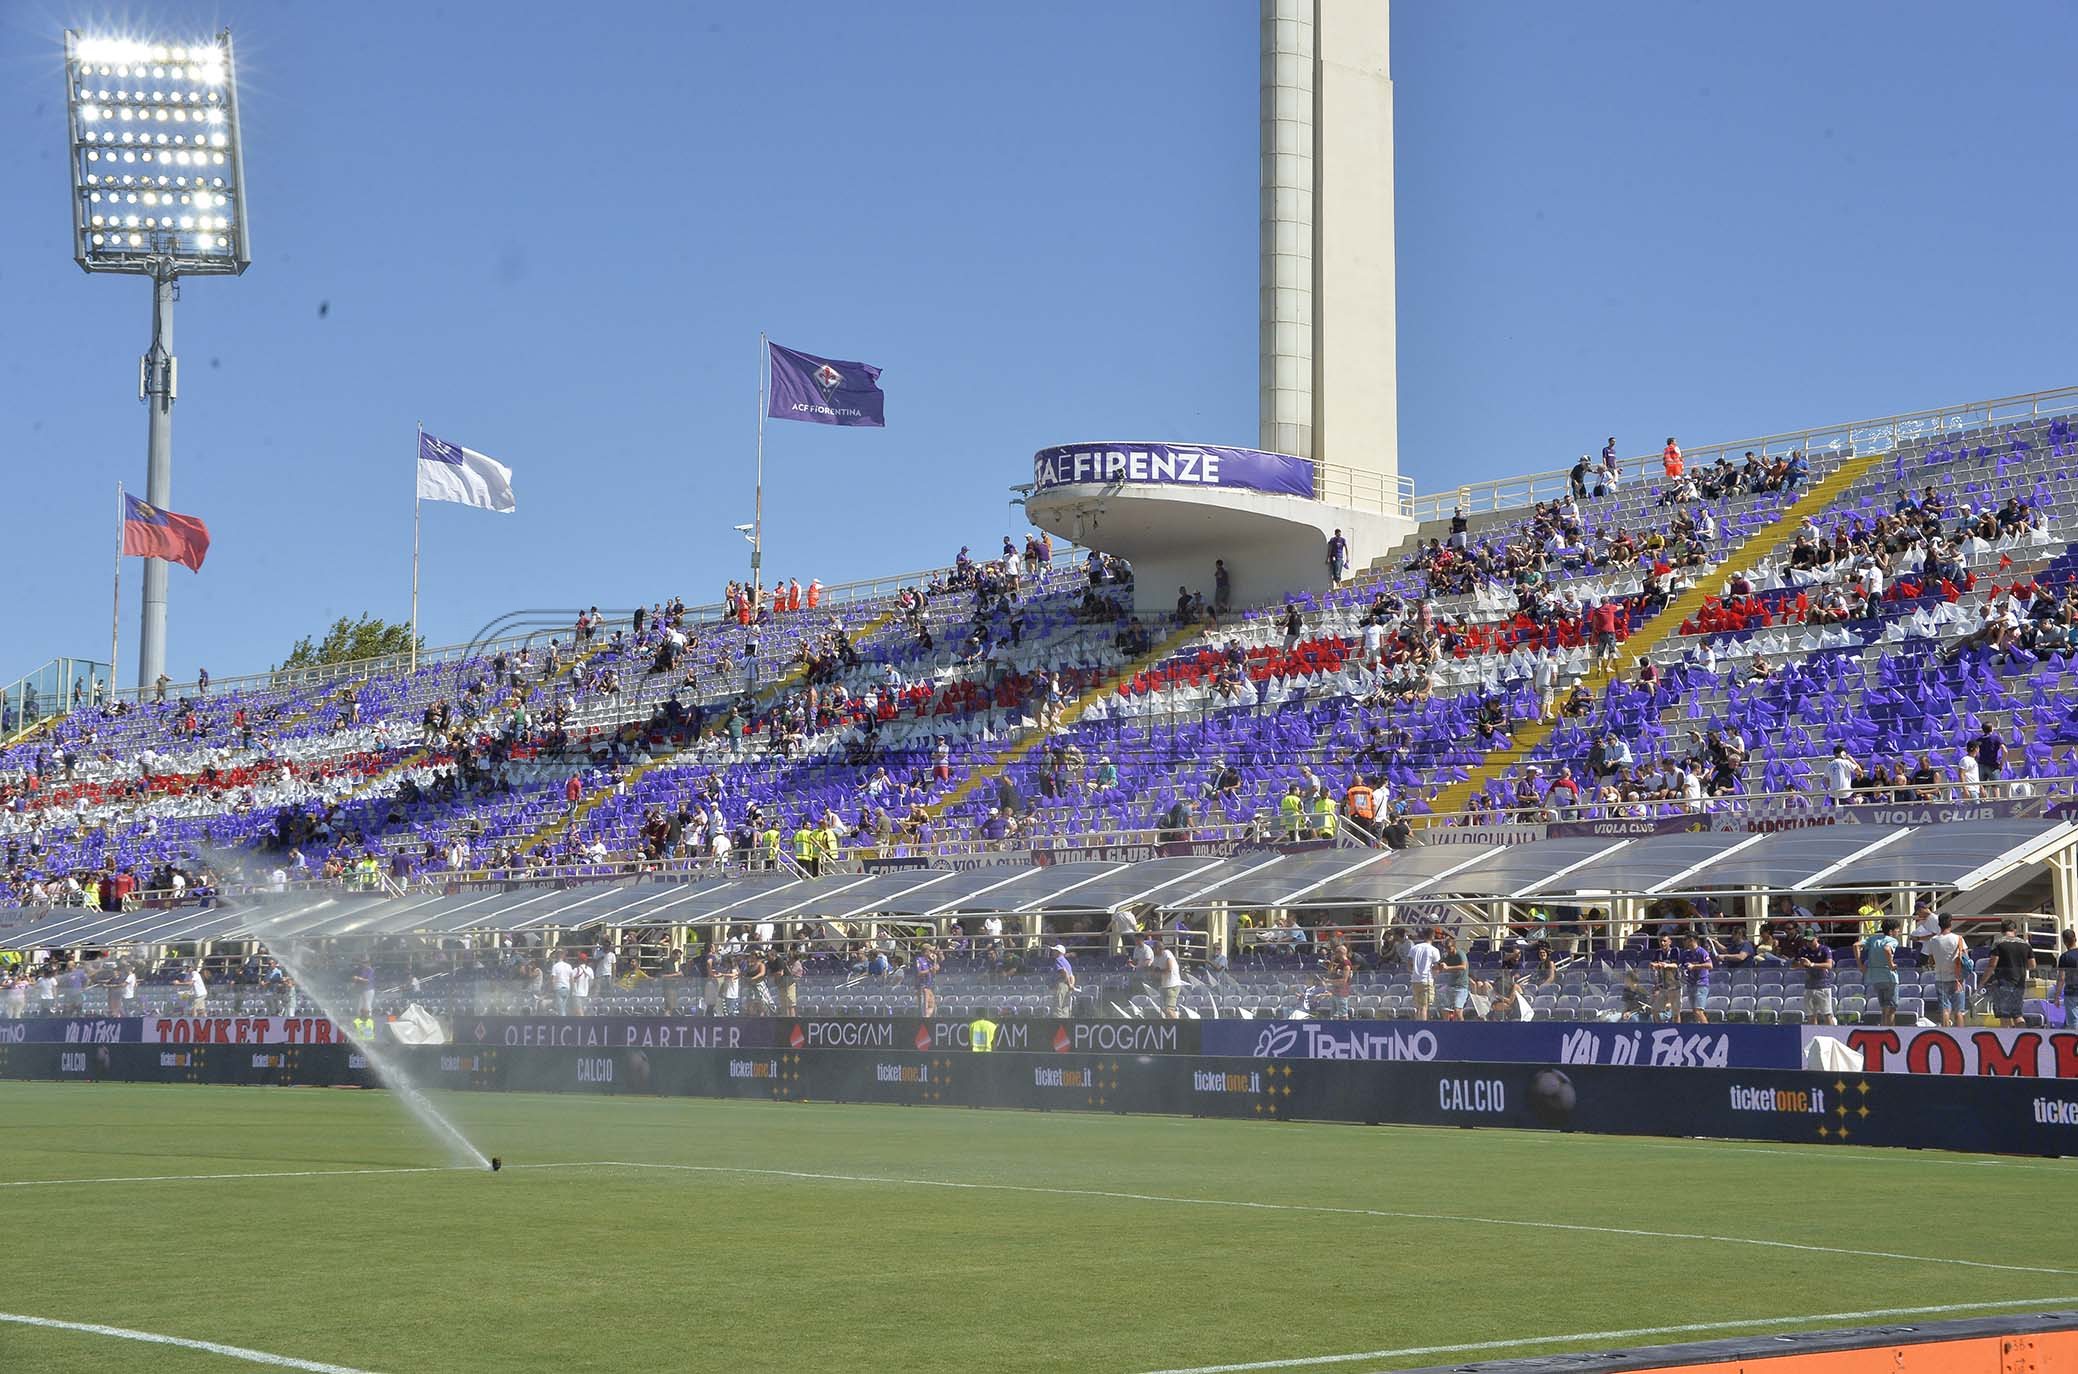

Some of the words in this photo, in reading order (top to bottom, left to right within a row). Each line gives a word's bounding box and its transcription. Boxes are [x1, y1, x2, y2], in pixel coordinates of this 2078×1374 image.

[792, 403, 809, 412] ACF
[1074, 451, 1219, 483] FIRENZE
[1874, 810, 1932, 824] VIOLA
[1939, 807, 1995, 823] CLUB
[1594, 823, 1626, 834] VIOLA
[1629, 822, 1655, 833] CLUB
[1054, 848, 1101, 865] VIOLA
[1106, 847, 1149, 862] CLUB
[156, 1018, 270, 1044] TOMKET
[504, 1025, 608, 1046] OFFICIAL
[626, 1026, 741, 1048] PARTNER
[1303, 1024, 1438, 1061] TRENTINO
[1651, 1028, 1729, 1067] FASSA
[61, 1053, 87, 1071] CALCIO
[577, 1058, 613, 1082] CALCIO
[1035, 1066, 1092, 1087] ticketone.it
[1194, 1070, 1261, 1094] ticketone.it
[1439, 1078, 1505, 1112] CALCIO
[1730, 1084, 1825, 1114] ticketone.it
